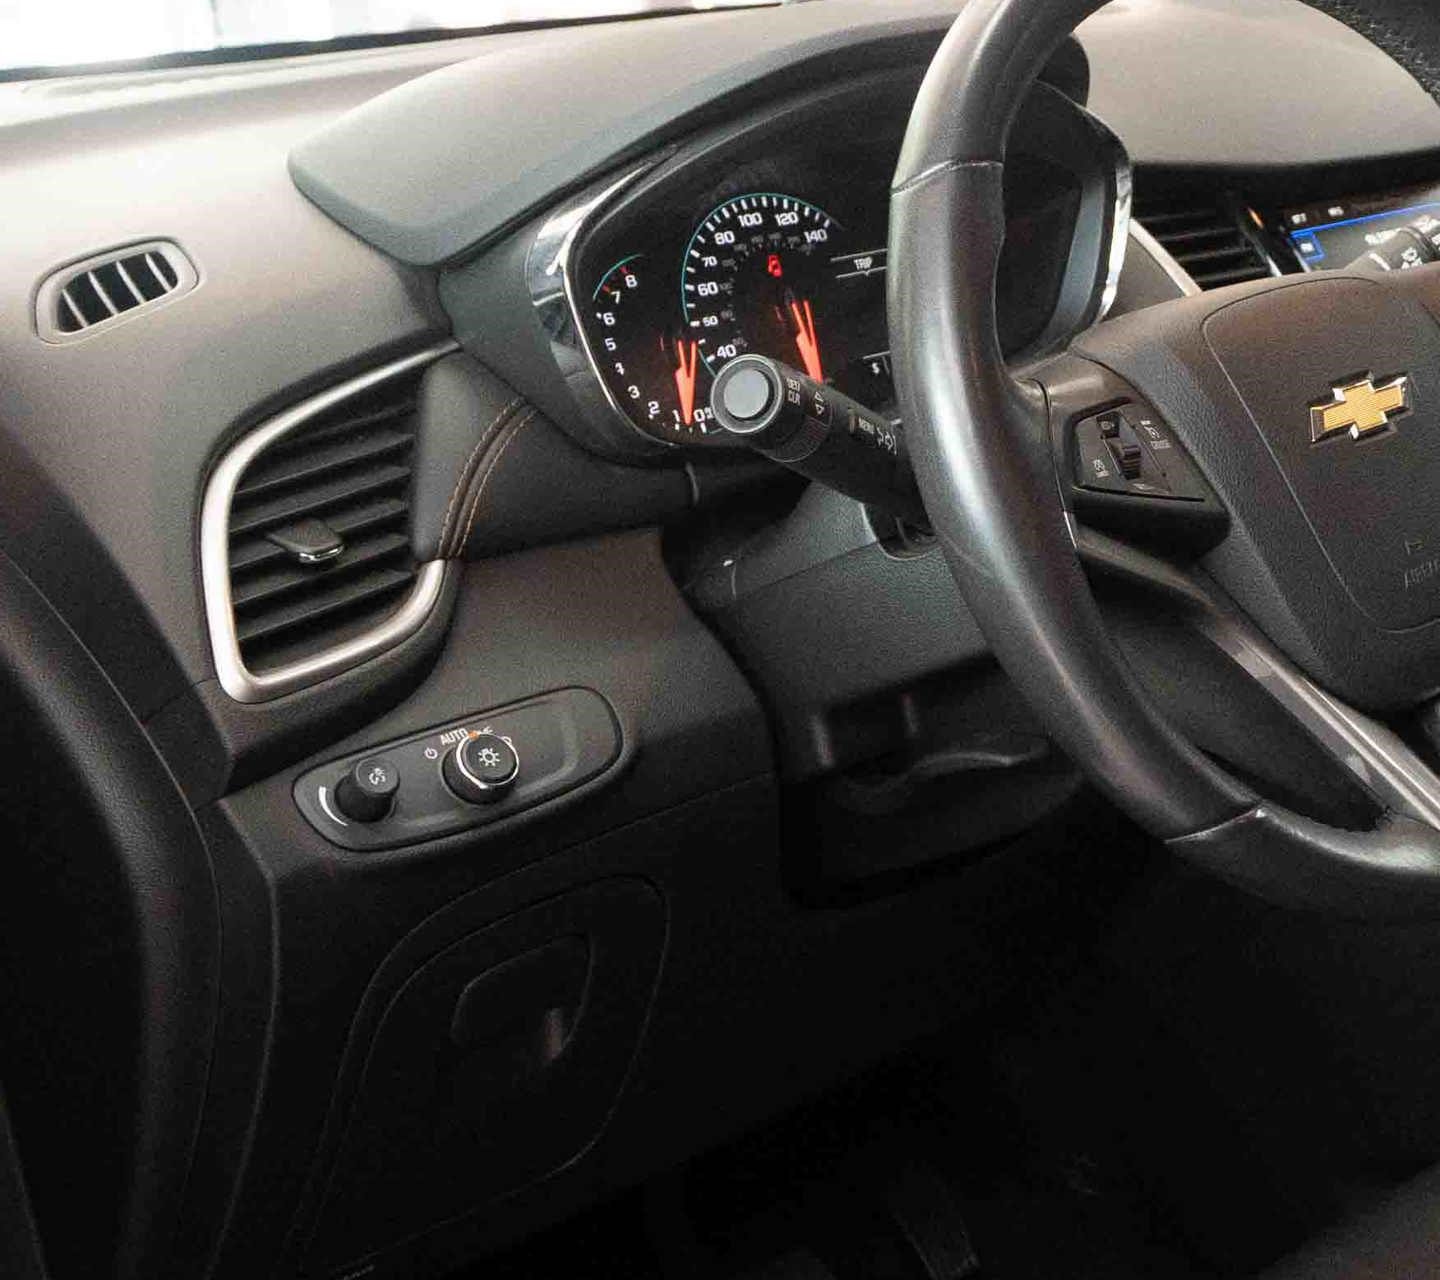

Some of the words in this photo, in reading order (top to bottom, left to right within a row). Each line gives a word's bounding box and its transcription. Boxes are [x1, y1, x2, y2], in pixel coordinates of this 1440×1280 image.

[737, 212, 763, 226] 100
[775, 211, 798, 225] 120
[714, 230, 735, 245] 80
[803, 228, 827, 243] 140
[701, 256, 717, 267] 70
[625, 274, 638, 288] 8
[697, 281, 719, 296] 60
[610, 290, 621, 304] 7
[602, 312, 616, 326] 6
[702, 315, 719, 327] 50
[604, 337, 617, 351] 5
[716, 344, 737, 358] 40
[627, 384, 641, 399] 3
[647, 400, 660, 415] 2
[440, 728, 470, 746] AUTO
